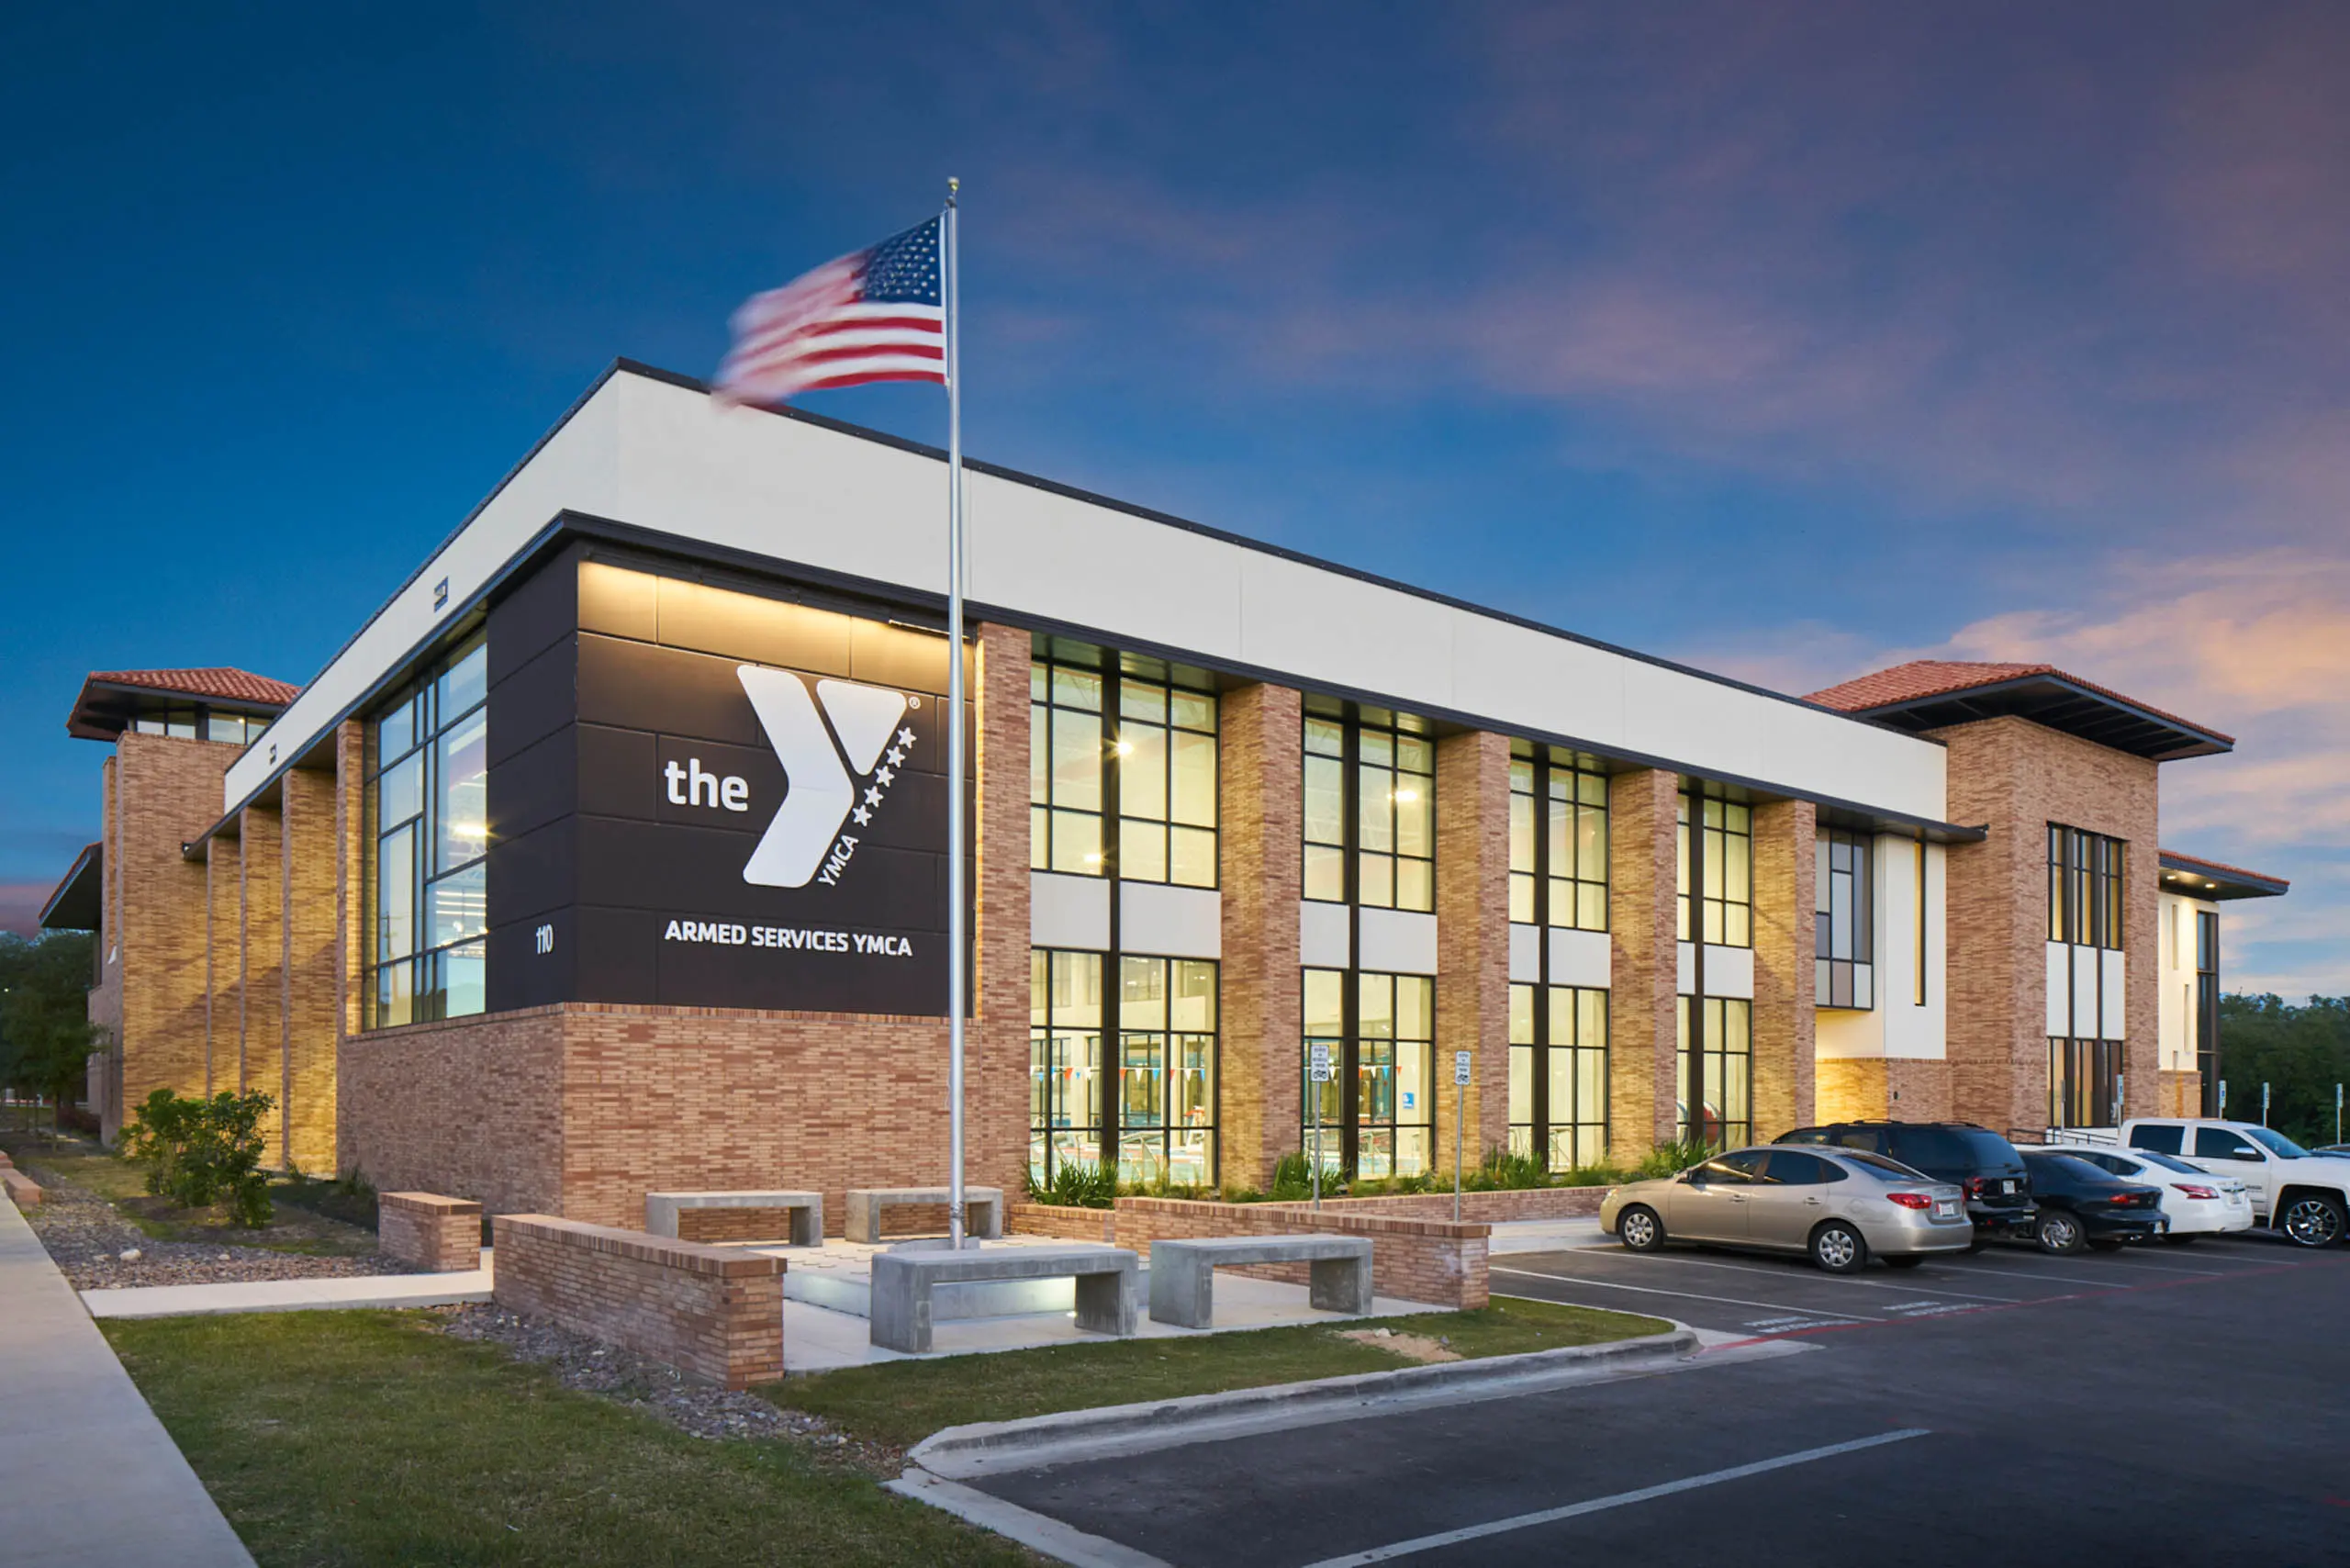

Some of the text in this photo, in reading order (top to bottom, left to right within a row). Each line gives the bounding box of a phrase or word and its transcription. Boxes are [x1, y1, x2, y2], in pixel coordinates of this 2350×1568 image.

[664, 758, 749, 812] the
[818, 834, 859, 886] YMCA
[536, 924, 554, 955] 110
[665, 920, 912, 957] ARMED SERVICES YMCA
